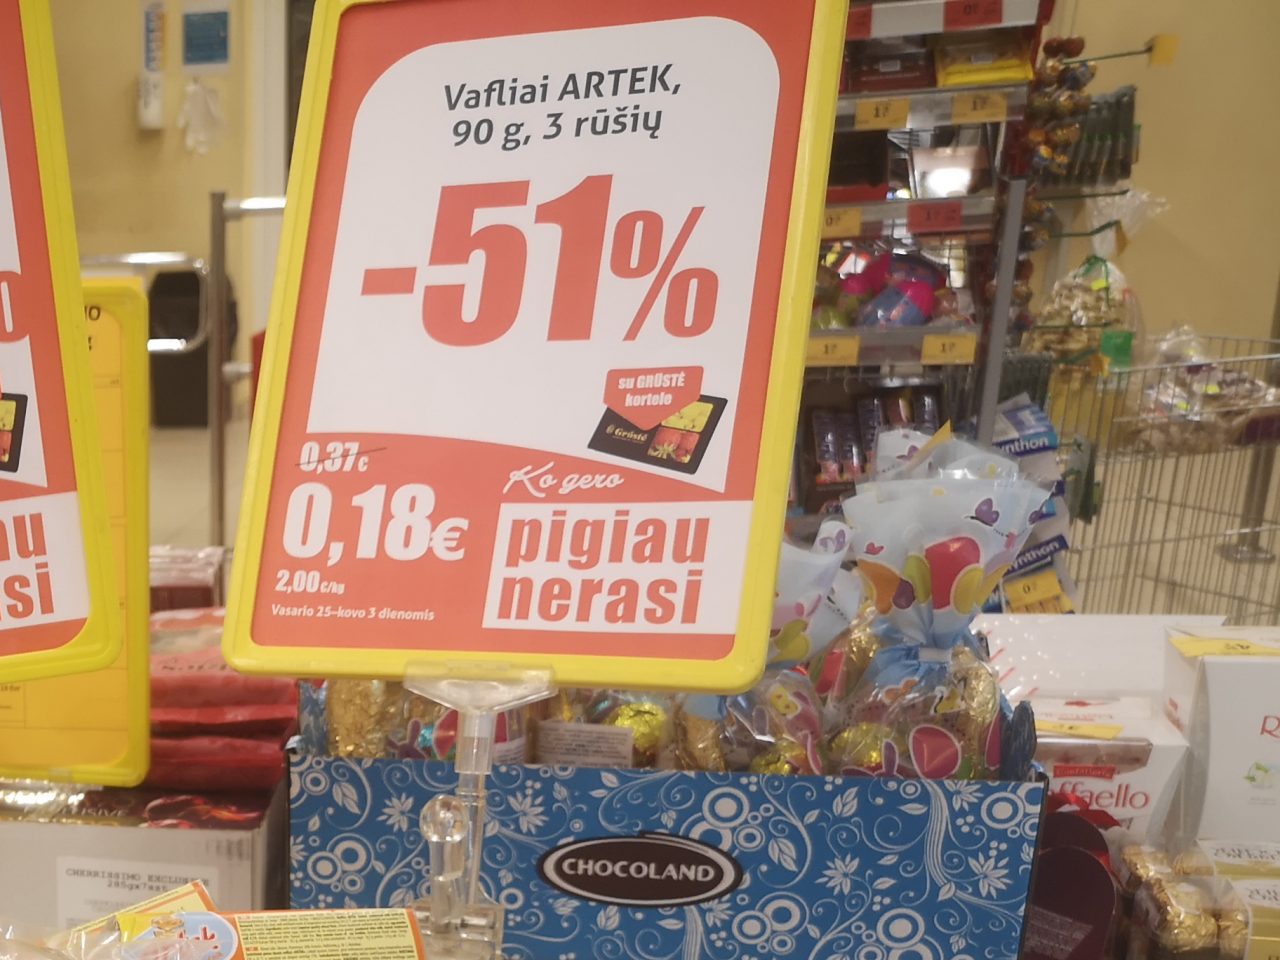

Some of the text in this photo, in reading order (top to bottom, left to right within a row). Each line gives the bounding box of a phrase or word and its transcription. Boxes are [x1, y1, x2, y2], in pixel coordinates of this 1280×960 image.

[443, 63, 682, 112] Vafliai ARTEK,
[452, 103, 663, 151] 90 g, 3 rūšių
[361, 174, 719, 348] -51%
[618, 376, 634, 389] su
[502, 461, 624, 498] Ko gero
[283, 482, 469, 567] 0,18€
[505, 510, 710, 570] pigiau
[272, 604, 313, 617] Vasario
[368, 608, 376, 618] 3
[379, 608, 435, 621] dienomis
[497, 570, 703, 625] nerasi
[562, 857, 715, 882] CHOCOLAND
